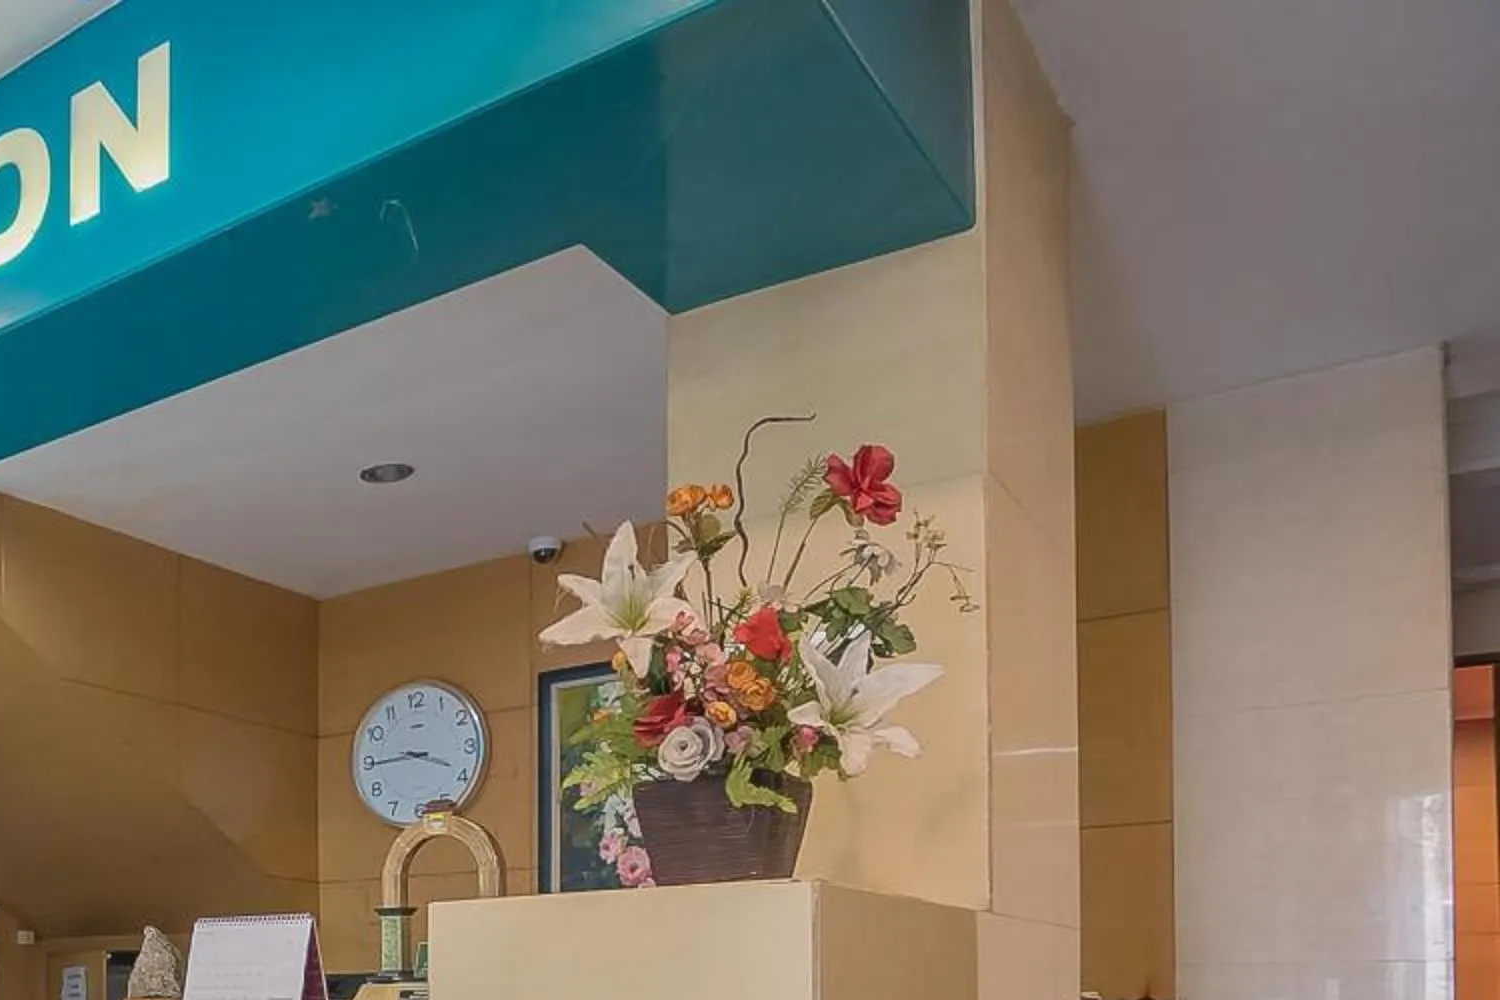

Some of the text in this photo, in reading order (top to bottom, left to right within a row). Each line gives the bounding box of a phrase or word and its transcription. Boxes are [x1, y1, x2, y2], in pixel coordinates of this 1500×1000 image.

[407, 691, 425, 708] 12
[386, 706, 396, 721] 11
[455, 709, 468, 726] 2
[367, 725, 385, 742] 10
[463, 738, 475, 754] 3
[363, 755, 375, 770] 9
[456, 767, 469, 784] 4
[371, 781, 383, 797] 8
[387, 800, 399, 817] 7
